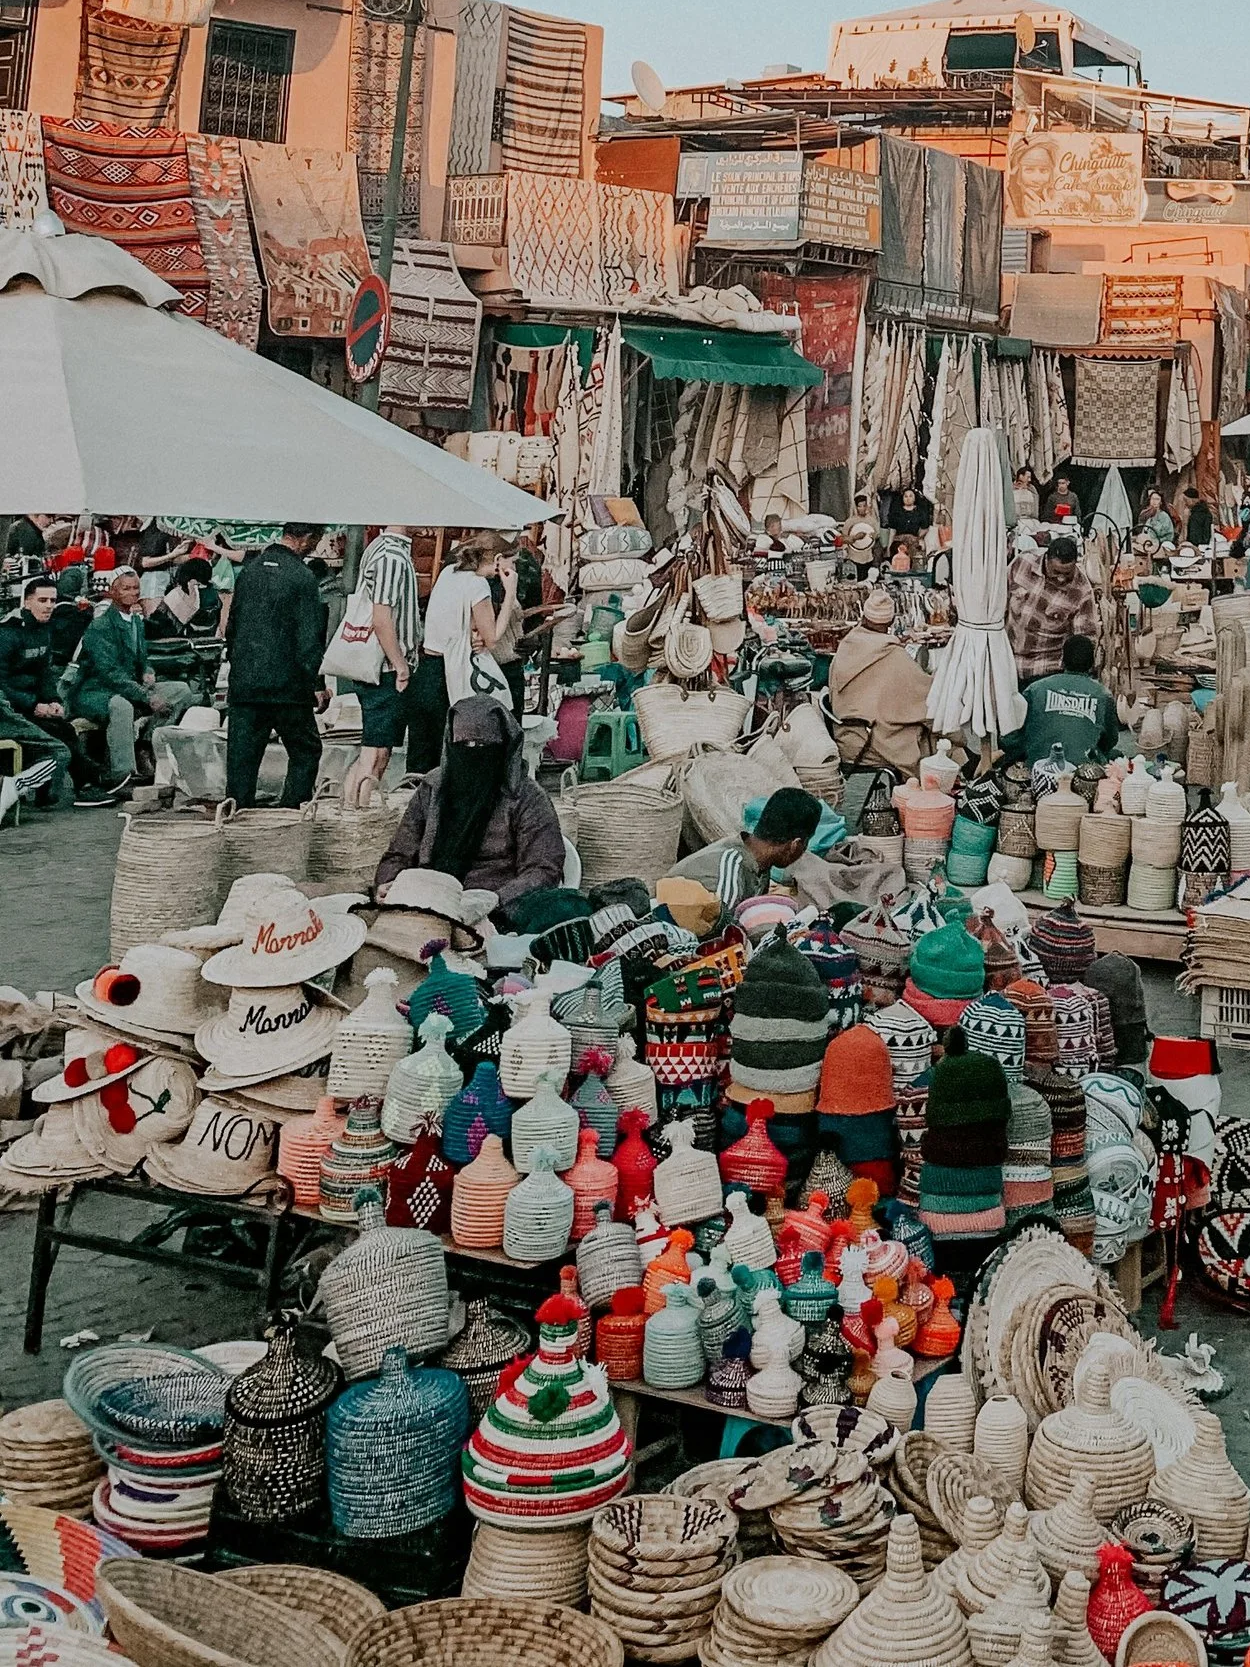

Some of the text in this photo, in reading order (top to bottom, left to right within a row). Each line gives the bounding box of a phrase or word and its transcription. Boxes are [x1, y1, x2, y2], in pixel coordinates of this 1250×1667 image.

[711, 171, 721, 182] LE
[711, 183, 720, 193] LA
[722, 183, 744, 193] VENTE
[1045, 689, 1098, 724] LONSDALE
